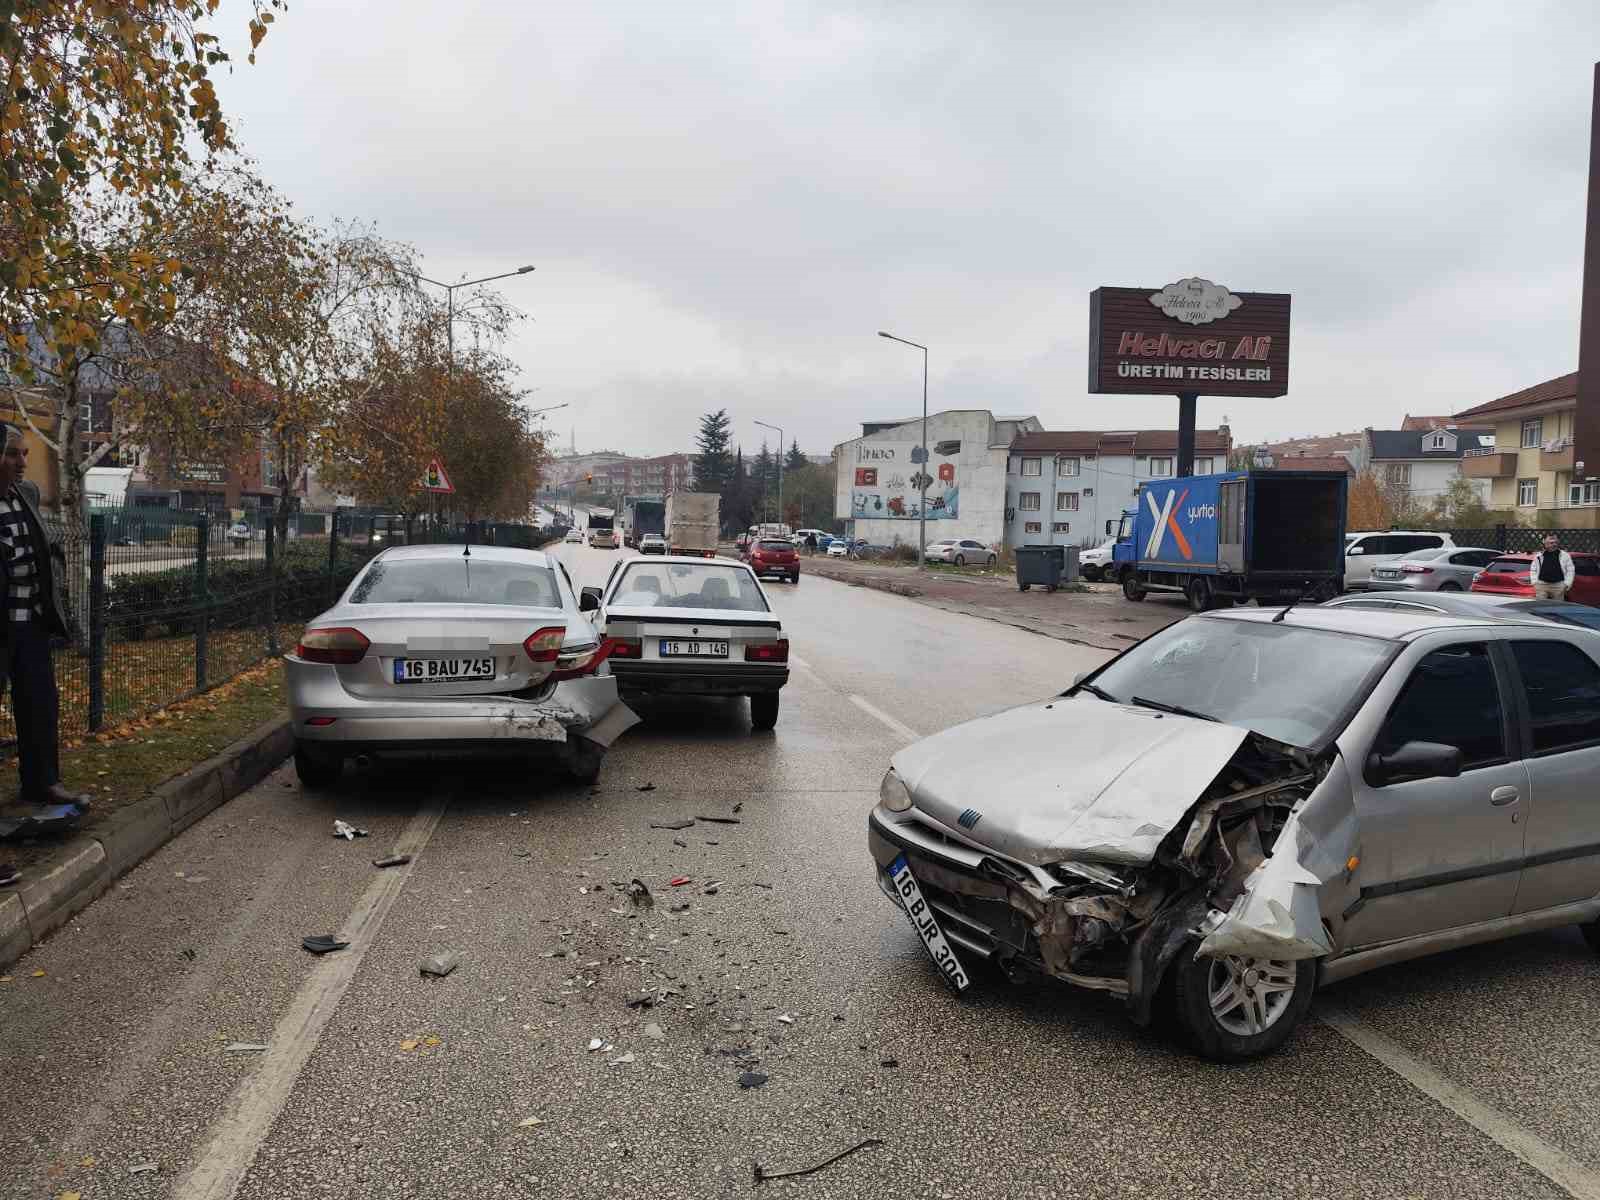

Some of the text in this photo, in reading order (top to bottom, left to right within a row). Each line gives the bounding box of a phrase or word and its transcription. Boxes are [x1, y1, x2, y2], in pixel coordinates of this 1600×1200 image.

[1231, 335, 1272, 361] Ali
[1117, 360, 1272, 382] ÜRETİM TESİSLERİ
[668, 642, 679, 653] 16
[687, 642, 700, 654] AD
[406, 659, 491, 677] 16 BAU 745
[897, 871, 916, 898] 16
[910, 898, 939, 943] BJR
